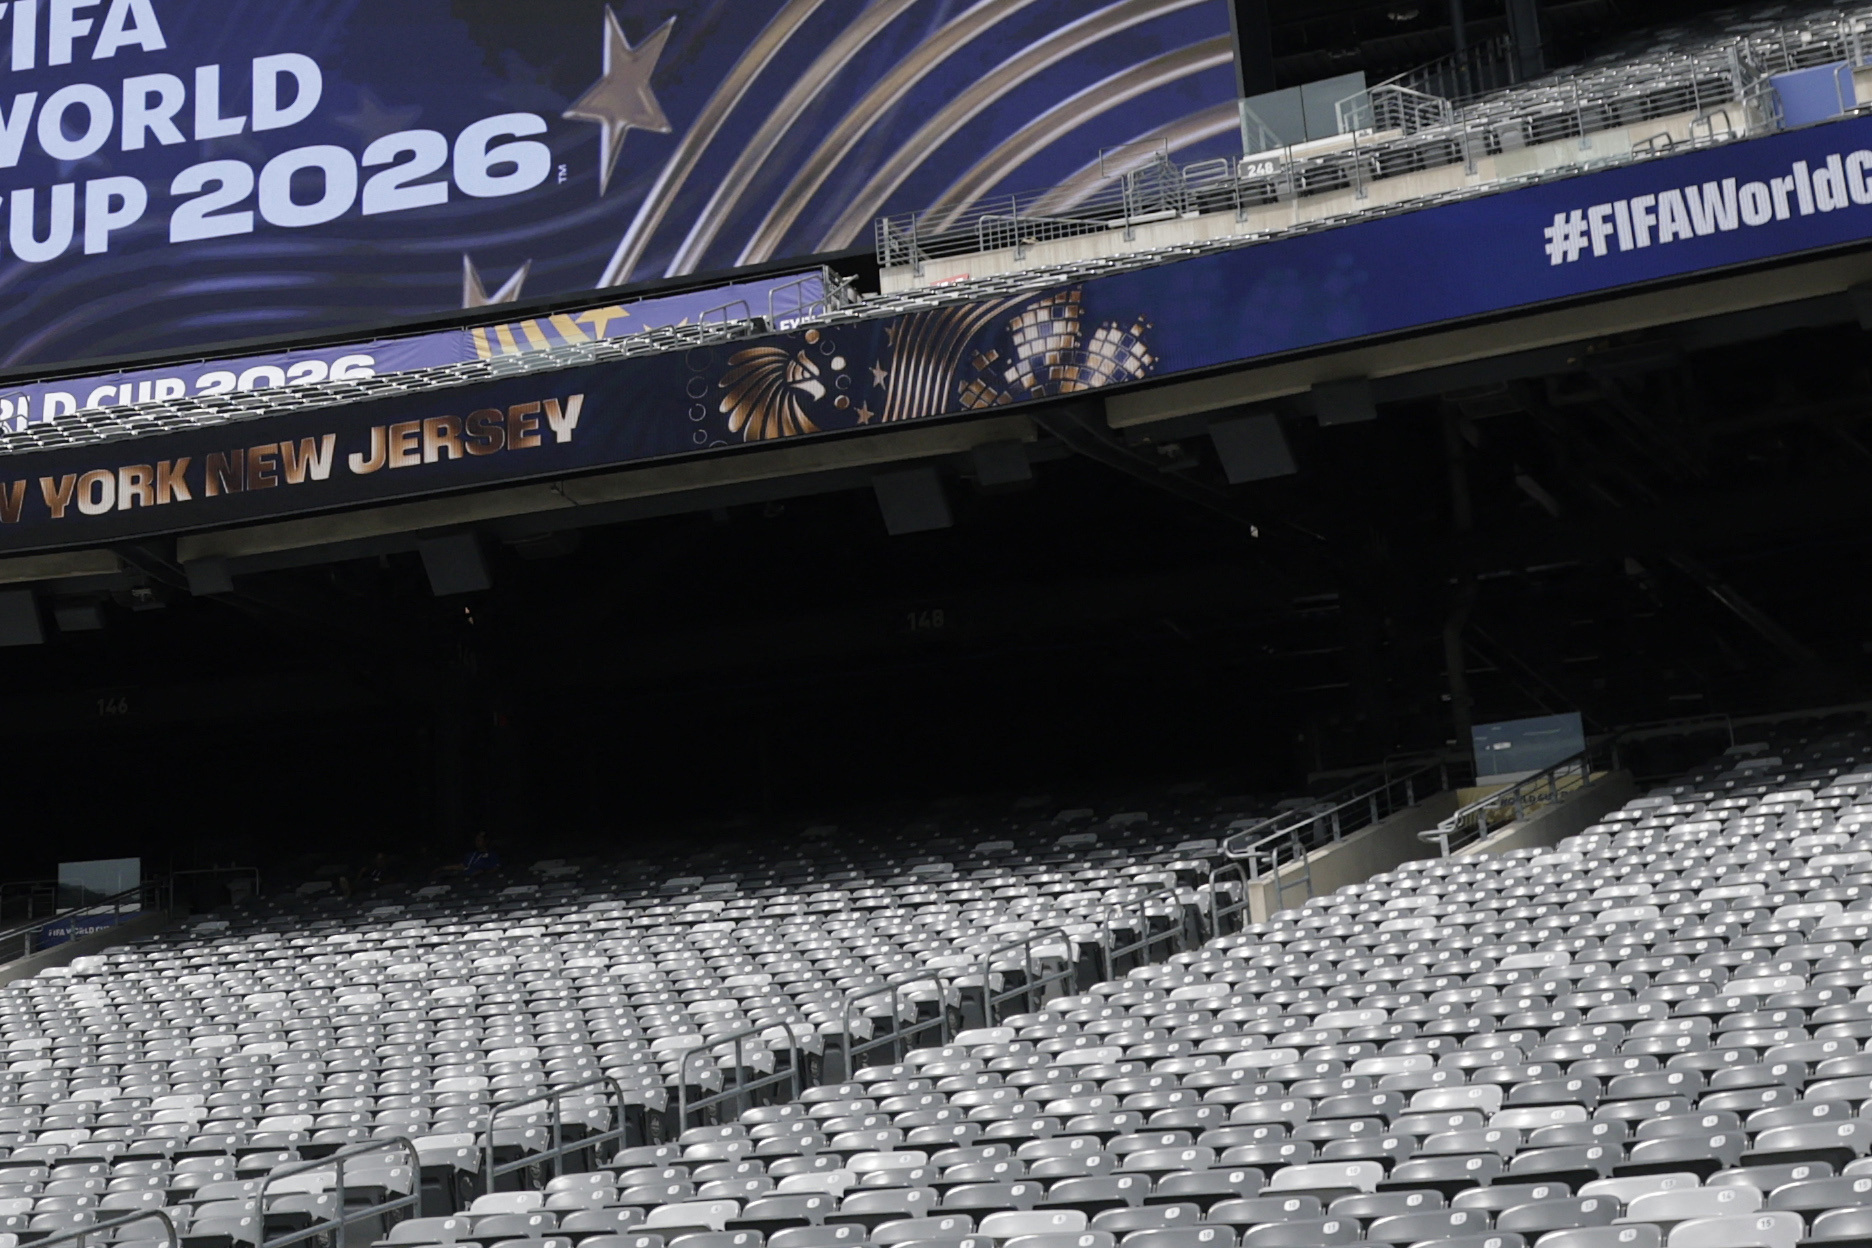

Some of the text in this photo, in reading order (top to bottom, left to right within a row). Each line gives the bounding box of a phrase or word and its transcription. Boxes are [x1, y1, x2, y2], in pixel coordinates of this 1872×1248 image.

[169, 112, 551, 244] 2026
[1248, 161, 1274, 177] 248
[1544, 149, 1872, 267] #FIFAWorldC
[39, 457, 191, 518] YORK
[205, 434, 336, 495] NEW
[348, 394, 584, 475] JERSEY
[97, 696, 129, 716] 146
